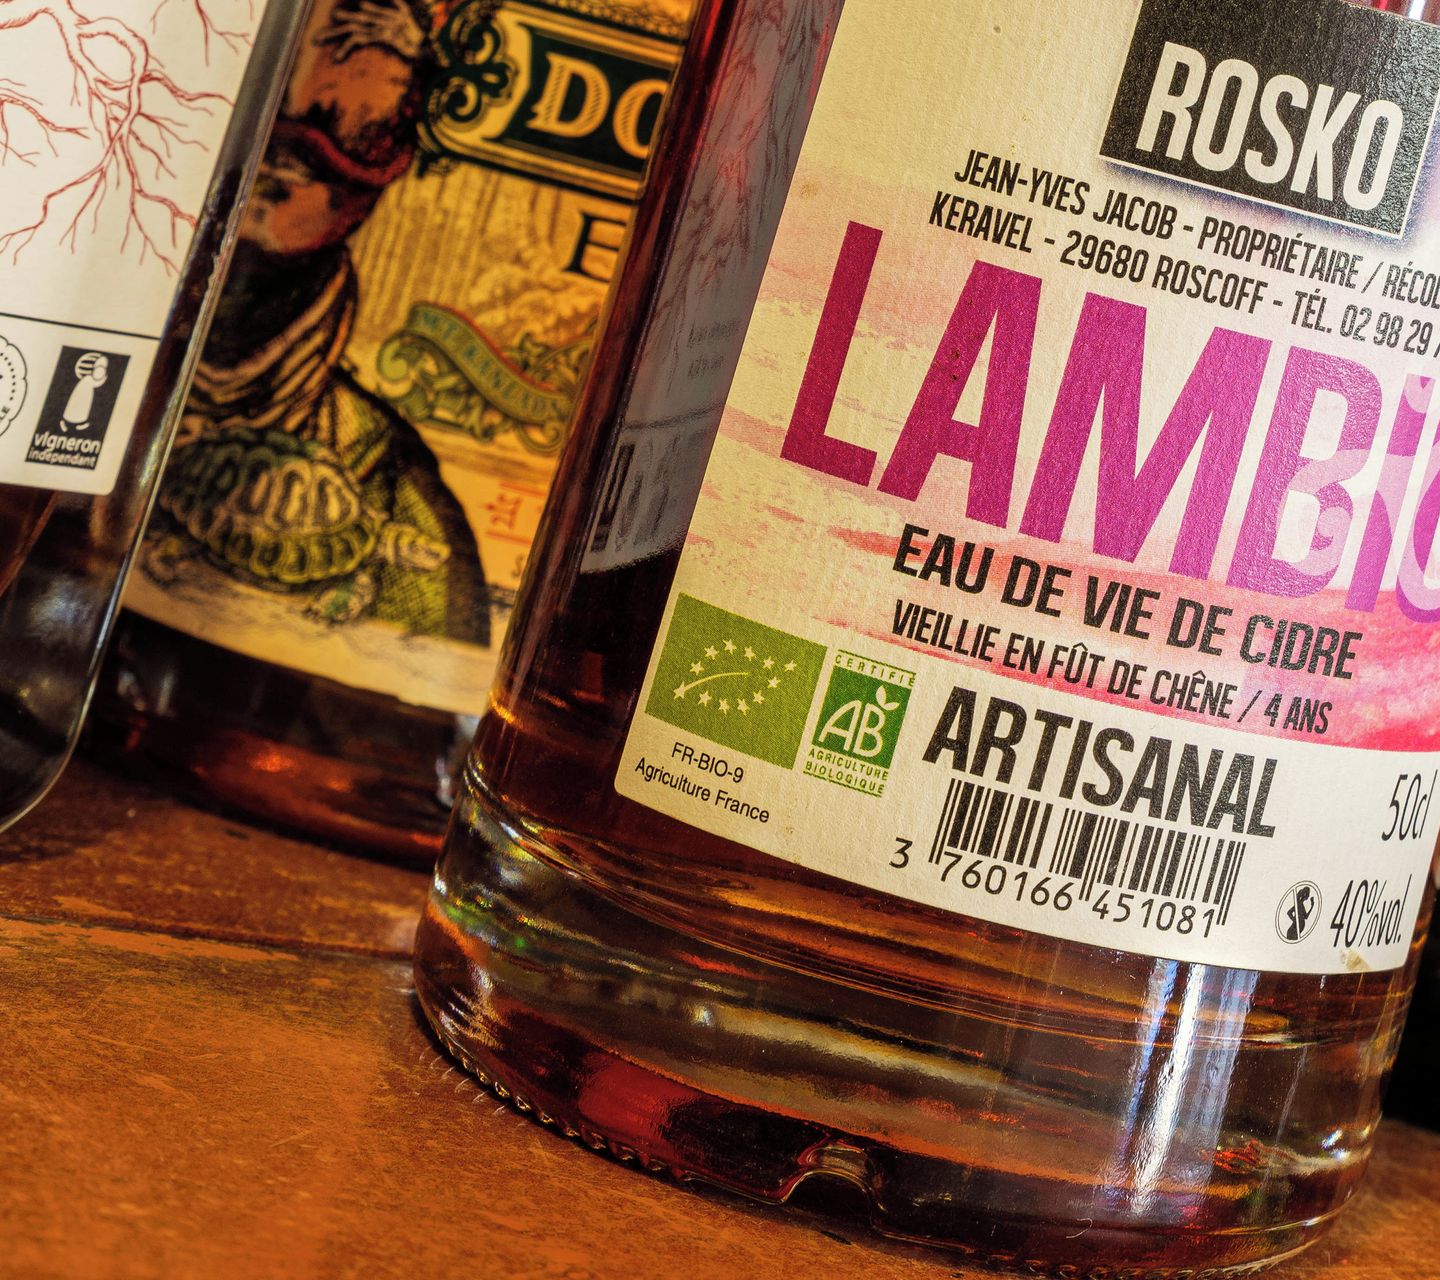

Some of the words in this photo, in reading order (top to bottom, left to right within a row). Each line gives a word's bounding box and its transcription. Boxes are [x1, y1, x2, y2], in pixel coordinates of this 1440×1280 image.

[1136, 41, 1403, 213] ROSKO
[954, 149, 1090, 215] JEAN-YVES
[1093, 189, 1178, 239] JACOB
[1197, 216, 1364, 289] PROPRIÉTAIRE
[928, 191, 1033, 253] KERAVEL
[1059, 230, 1150, 283] 29680
[1151, 255, 1268, 314] ROSCOFF
[1290, 288, 1332, 334] TÉL.
[1339, 304, 1372, 342] 02
[1373, 311, 1404, 349] 98
[1403, 319, 1433, 356] 29
[33, 431, 102, 455] vigneron
[892, 523, 994, 594] EAU
[1000, 555, 1071, 618] DE
[1083, 576, 1160, 640] VIE
[1166, 597, 1235, 656] DE
[1239, 614, 1362, 680] CIDRE
[892, 598, 1001, 663] VIEILLIE
[1004, 633, 1044, 679] EN
[1048, 643, 1106, 690] FÛT
[1107, 663, 1148, 701] DE
[1149, 669, 1239, 721] CHÊNE
[1263, 693, 1282, 728] 4
[1282, 696, 1333, 735] ANS
[671, 742, 744, 783] FR-BIO-9
[808, 747, 890, 781] AGRICULTURE
[819, 699, 886, 758] AB
[922, 685, 1278, 838] ARTISANAL
[634, 757, 711, 801] Agriculture
[714, 790, 770, 824] France
[805, 761, 885, 795] BIOLOGIQUE
[1381, 769, 1438, 841] 50cl
[889, 837, 913, 869] 3
[939, 851, 1073, 912] 760166
[1092, 889, 1216, 938] 451081
